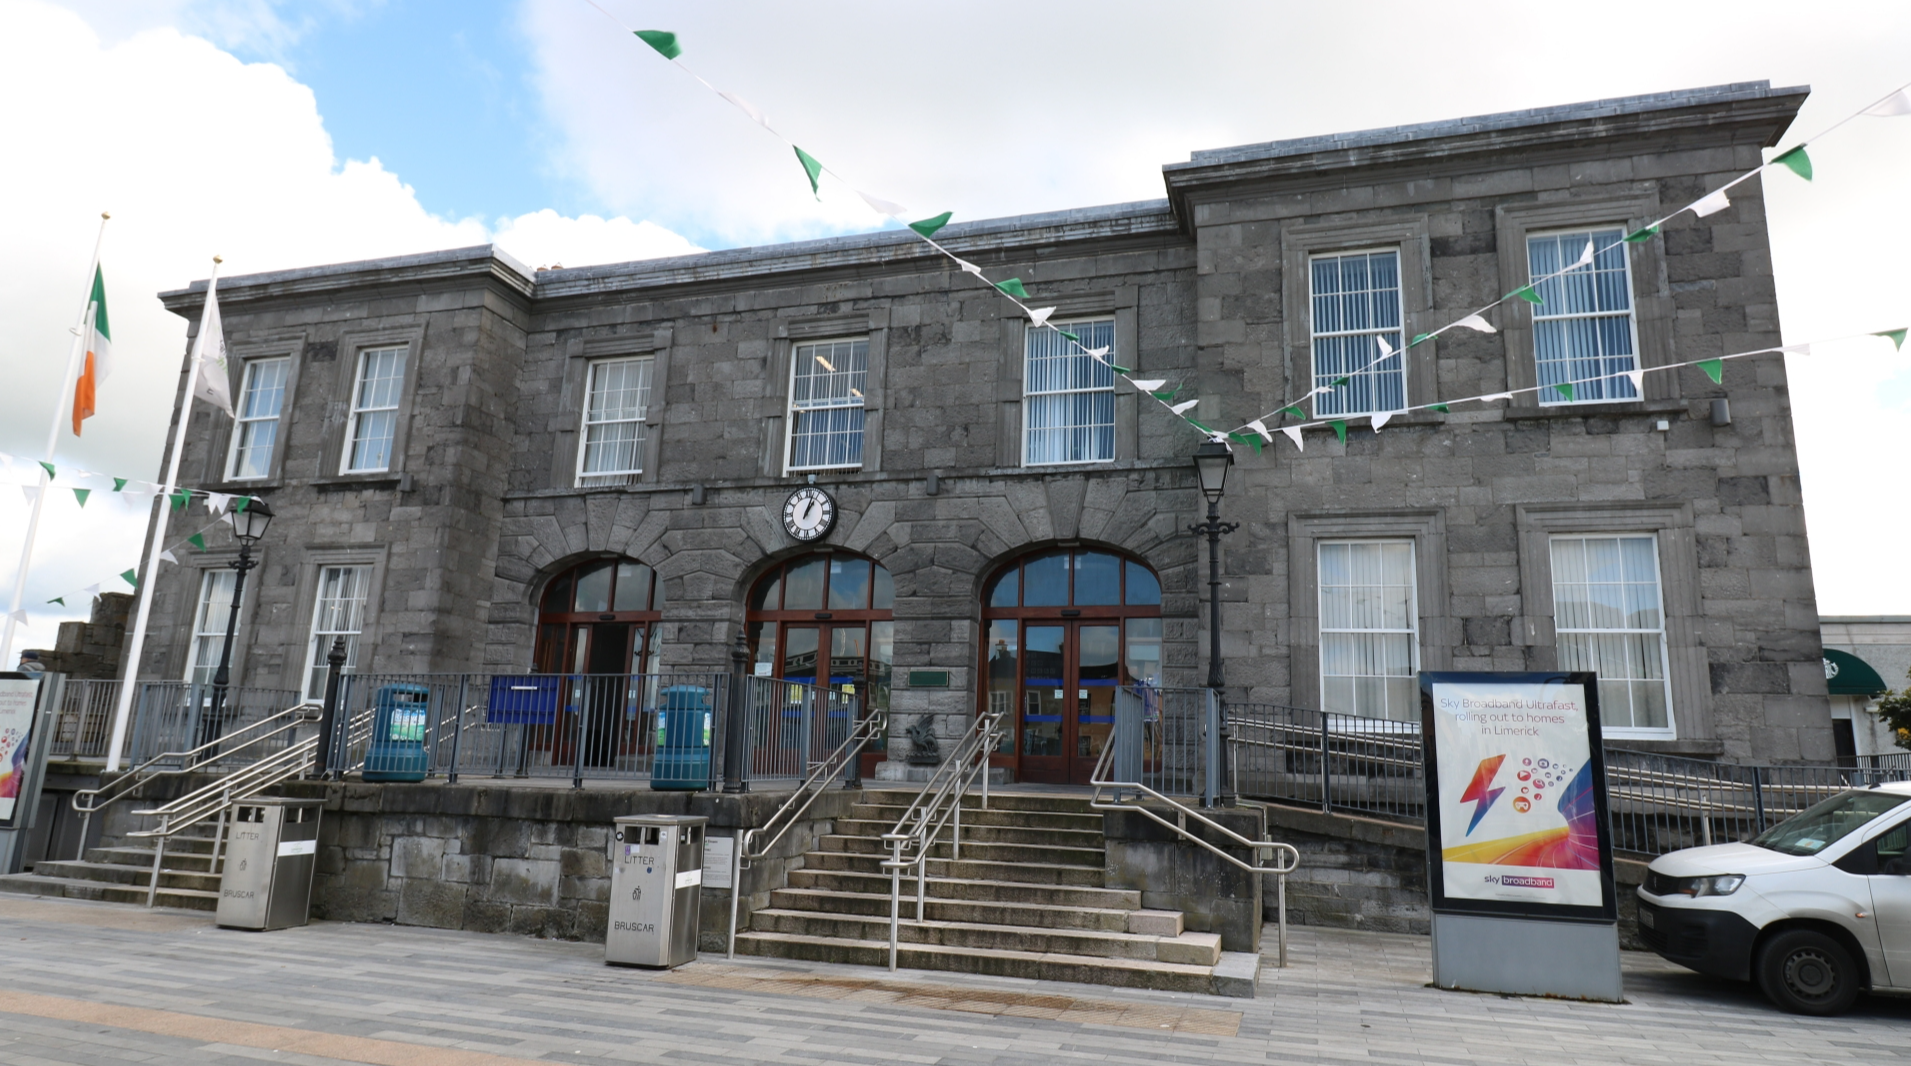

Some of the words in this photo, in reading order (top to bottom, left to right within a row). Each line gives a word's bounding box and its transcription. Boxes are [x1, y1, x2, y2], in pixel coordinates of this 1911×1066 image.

[1440, 698, 1460, 710] Sky
[1462, 699, 1523, 710] Broadband
[1526, 700, 1579, 711] Ultrafast,
[1455, 712, 1486, 724] rolling
[1490, 713, 1509, 722] out
[1512, 714, 1524, 722] to
[1527, 713, 1565, 724] homes
[1481, 725, 1491, 735] in
[1494, 725, 1539, 736] Limerick
[235, 832, 259, 840] LITTER
[624, 856, 655, 865] LITTER
[1484, 875, 1500, 885] sky
[1503, 876, 1553, 887] broadband
[223, 889, 254, 899] BRUSCAR
[614, 921, 655, 932] BRUSCAR
